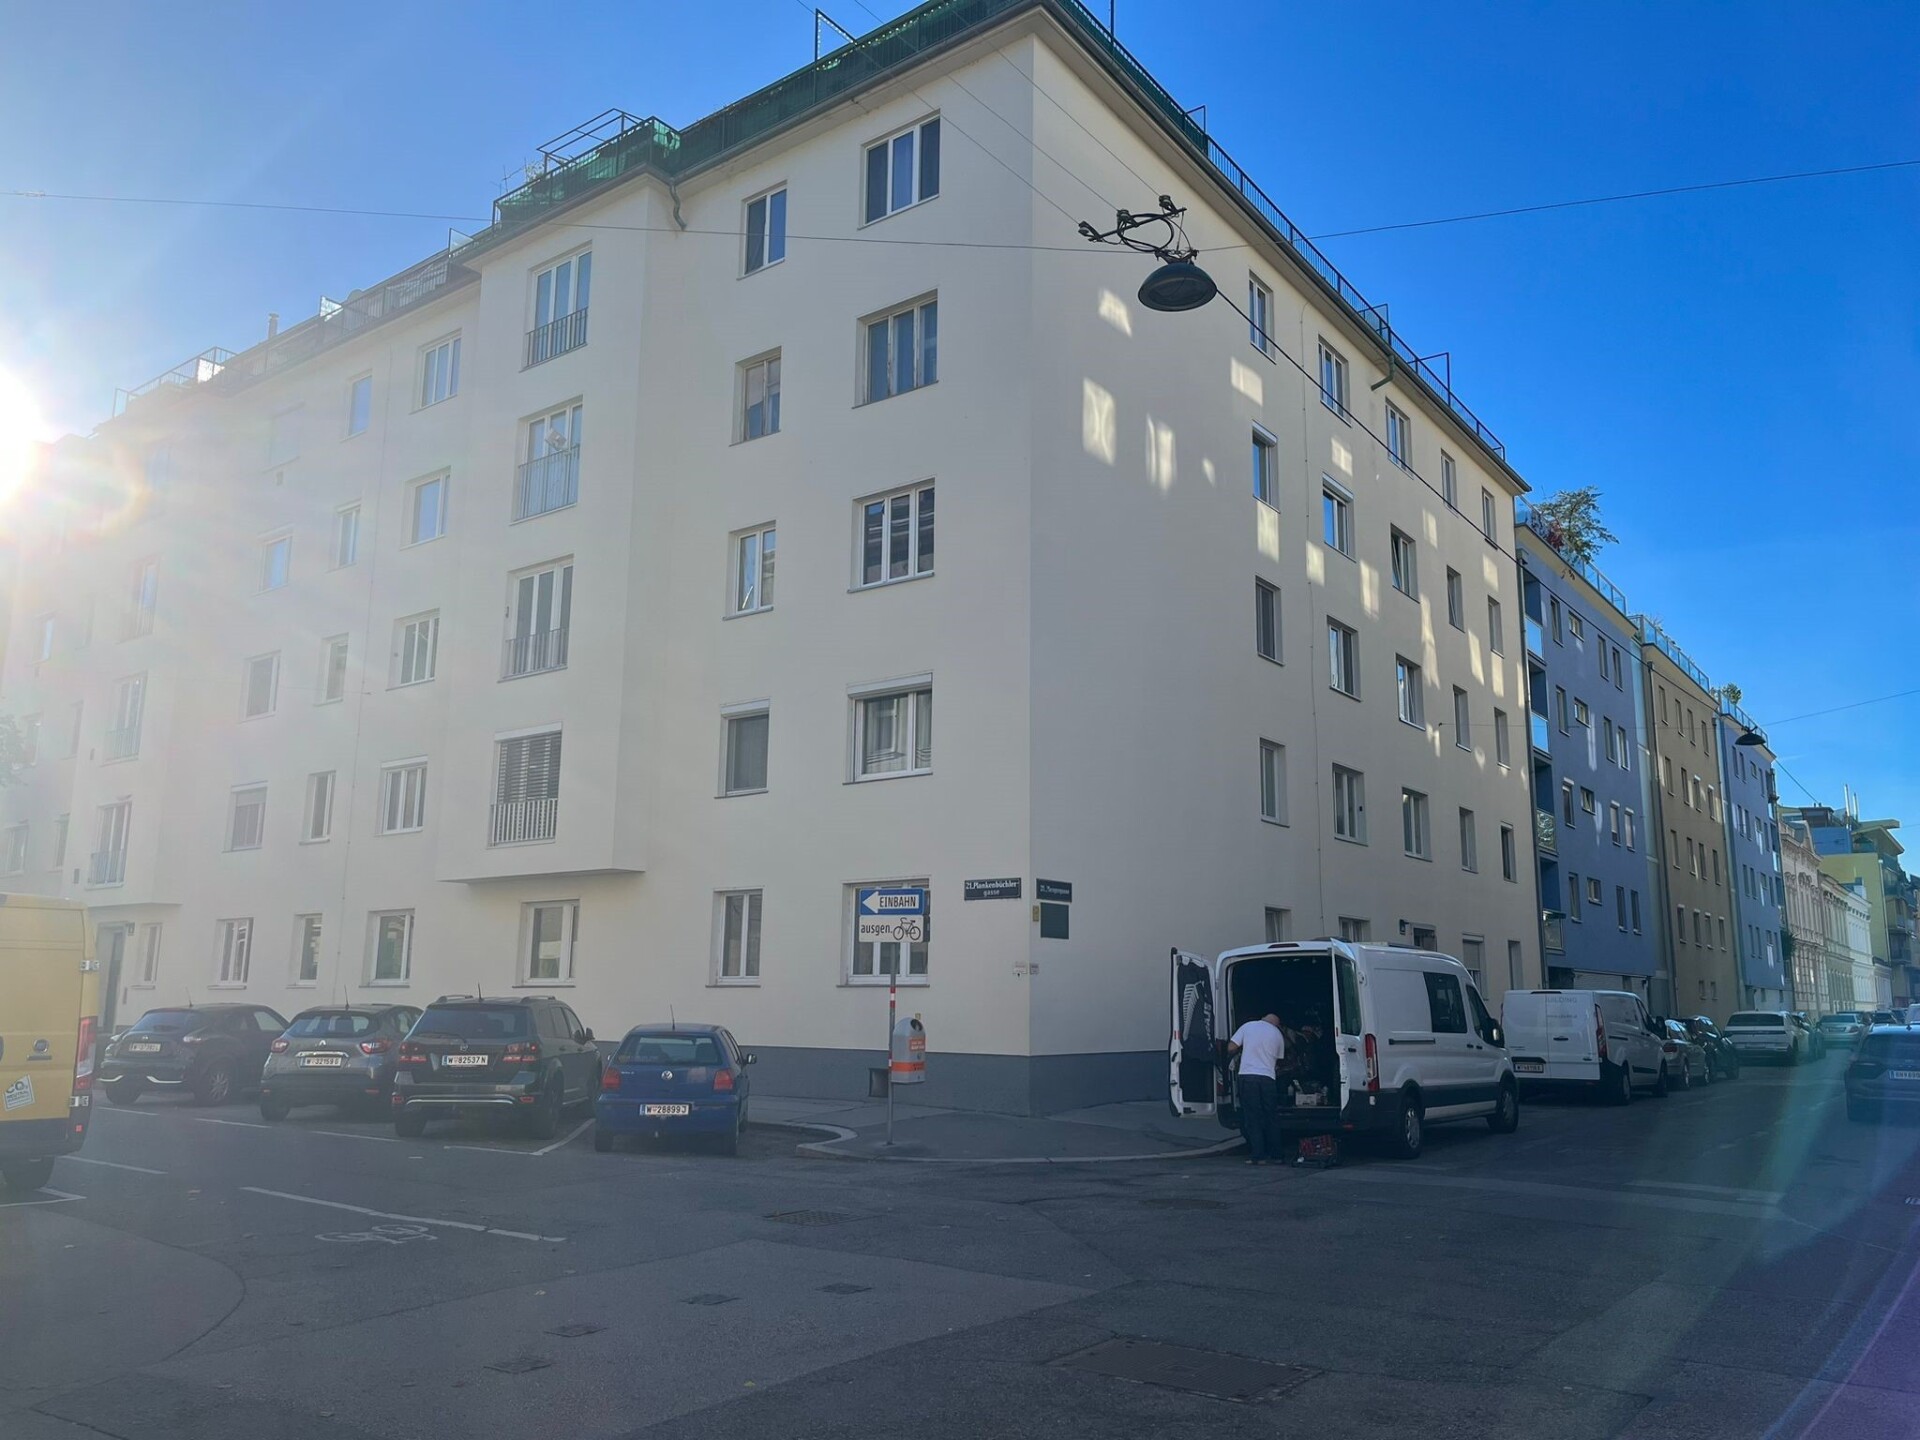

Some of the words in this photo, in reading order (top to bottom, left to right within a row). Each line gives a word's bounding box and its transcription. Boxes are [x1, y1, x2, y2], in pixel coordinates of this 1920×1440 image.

[983, 889, 1000, 898] gasse
[879, 896, 916, 908] EINBAHN
[860, 924, 893, 936] ausgen.
